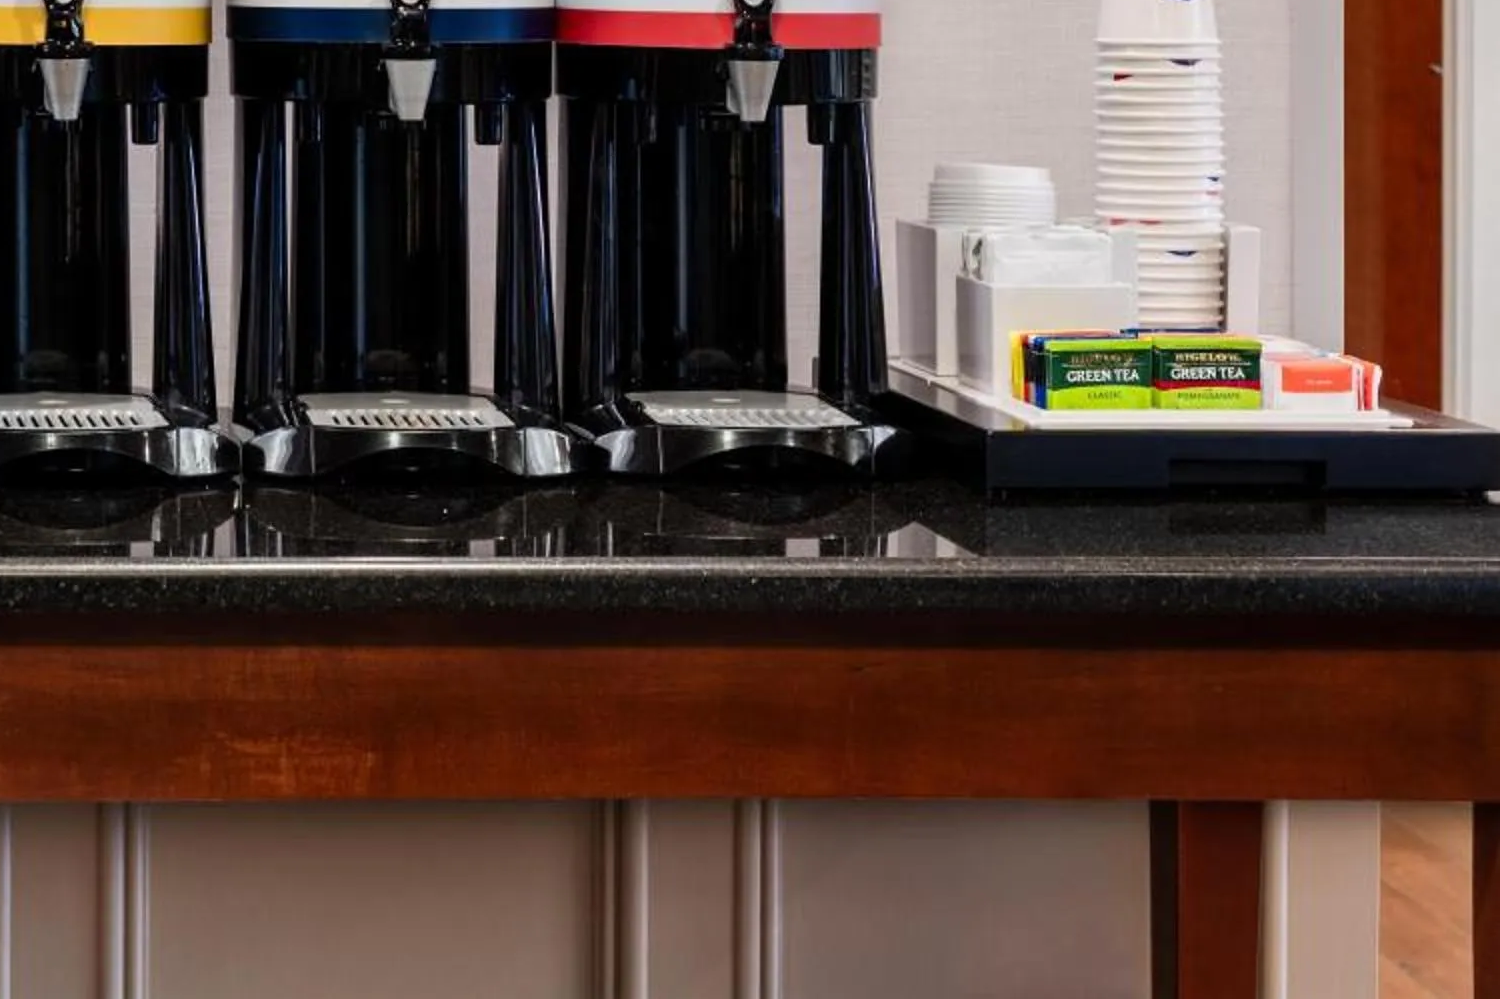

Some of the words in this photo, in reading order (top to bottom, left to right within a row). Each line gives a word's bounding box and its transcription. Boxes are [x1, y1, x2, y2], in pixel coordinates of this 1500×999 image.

[1067, 369, 1112, 383] GREEN
[1114, 368, 1141, 382] TEA
[1170, 367, 1216, 380] GREEN
[1218, 367, 1246, 379] TEA
